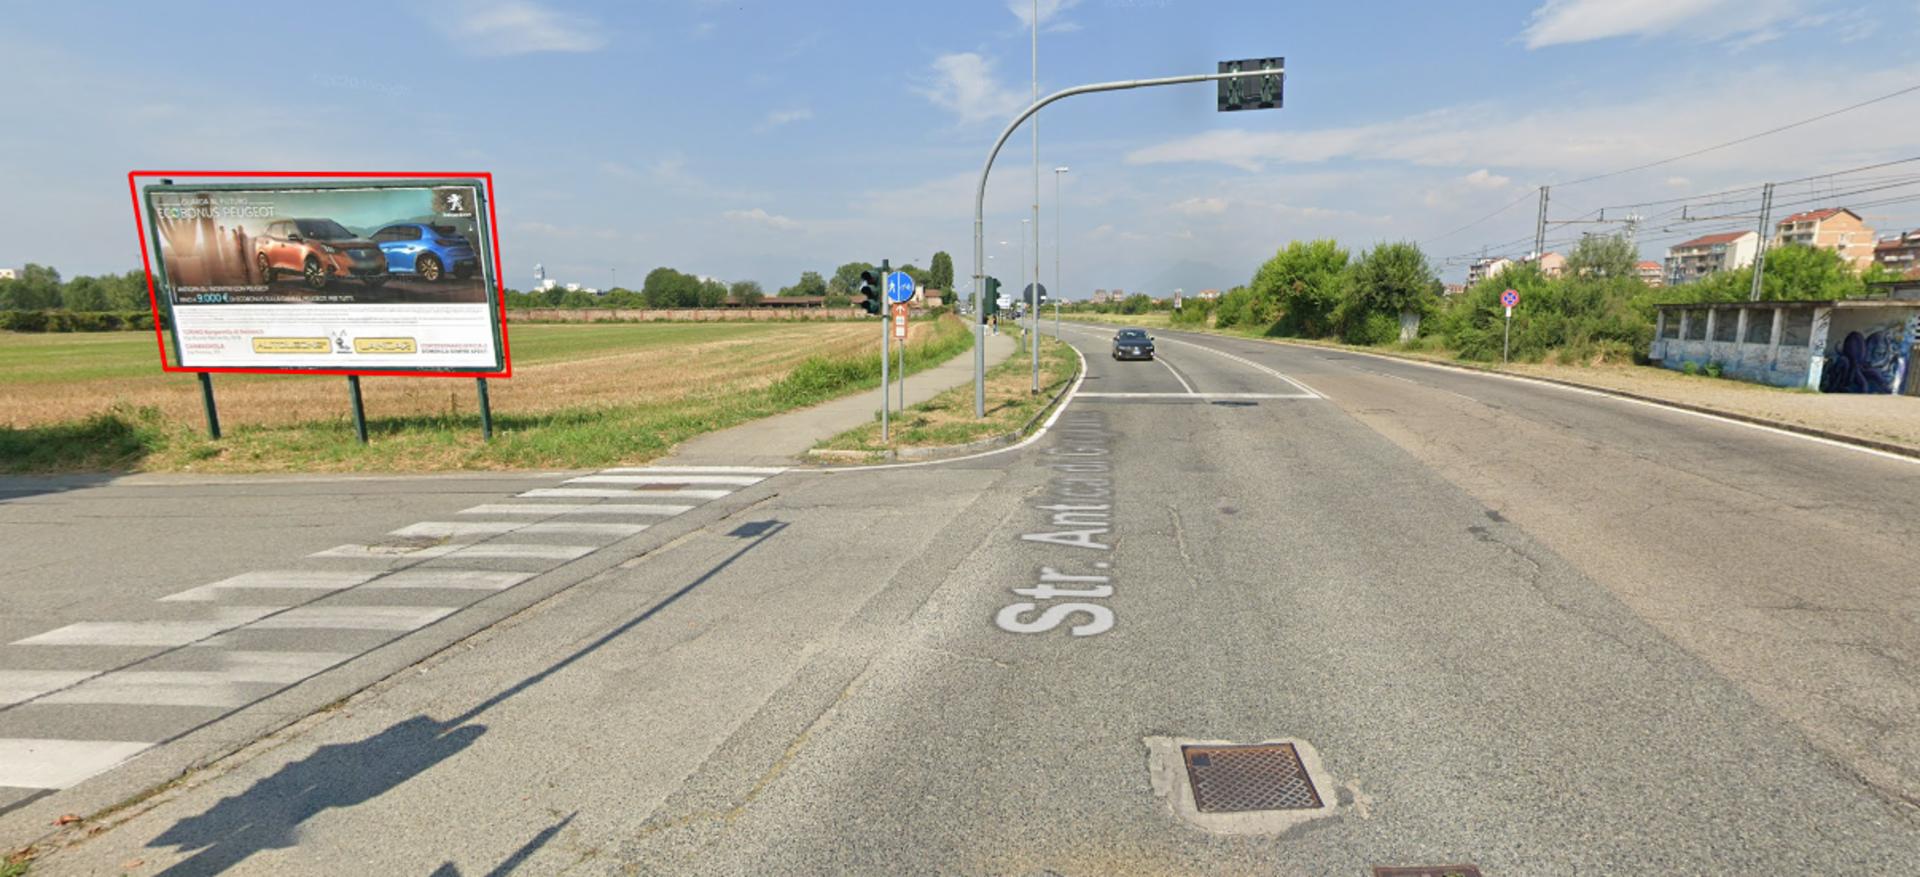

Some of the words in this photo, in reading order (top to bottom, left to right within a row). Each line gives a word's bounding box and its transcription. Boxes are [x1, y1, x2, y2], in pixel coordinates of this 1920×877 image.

[158, 206, 221, 219] ECOBONUS
[223, 206, 275, 218] PEUGEOT
[196, 293, 222, 303] 9.000
